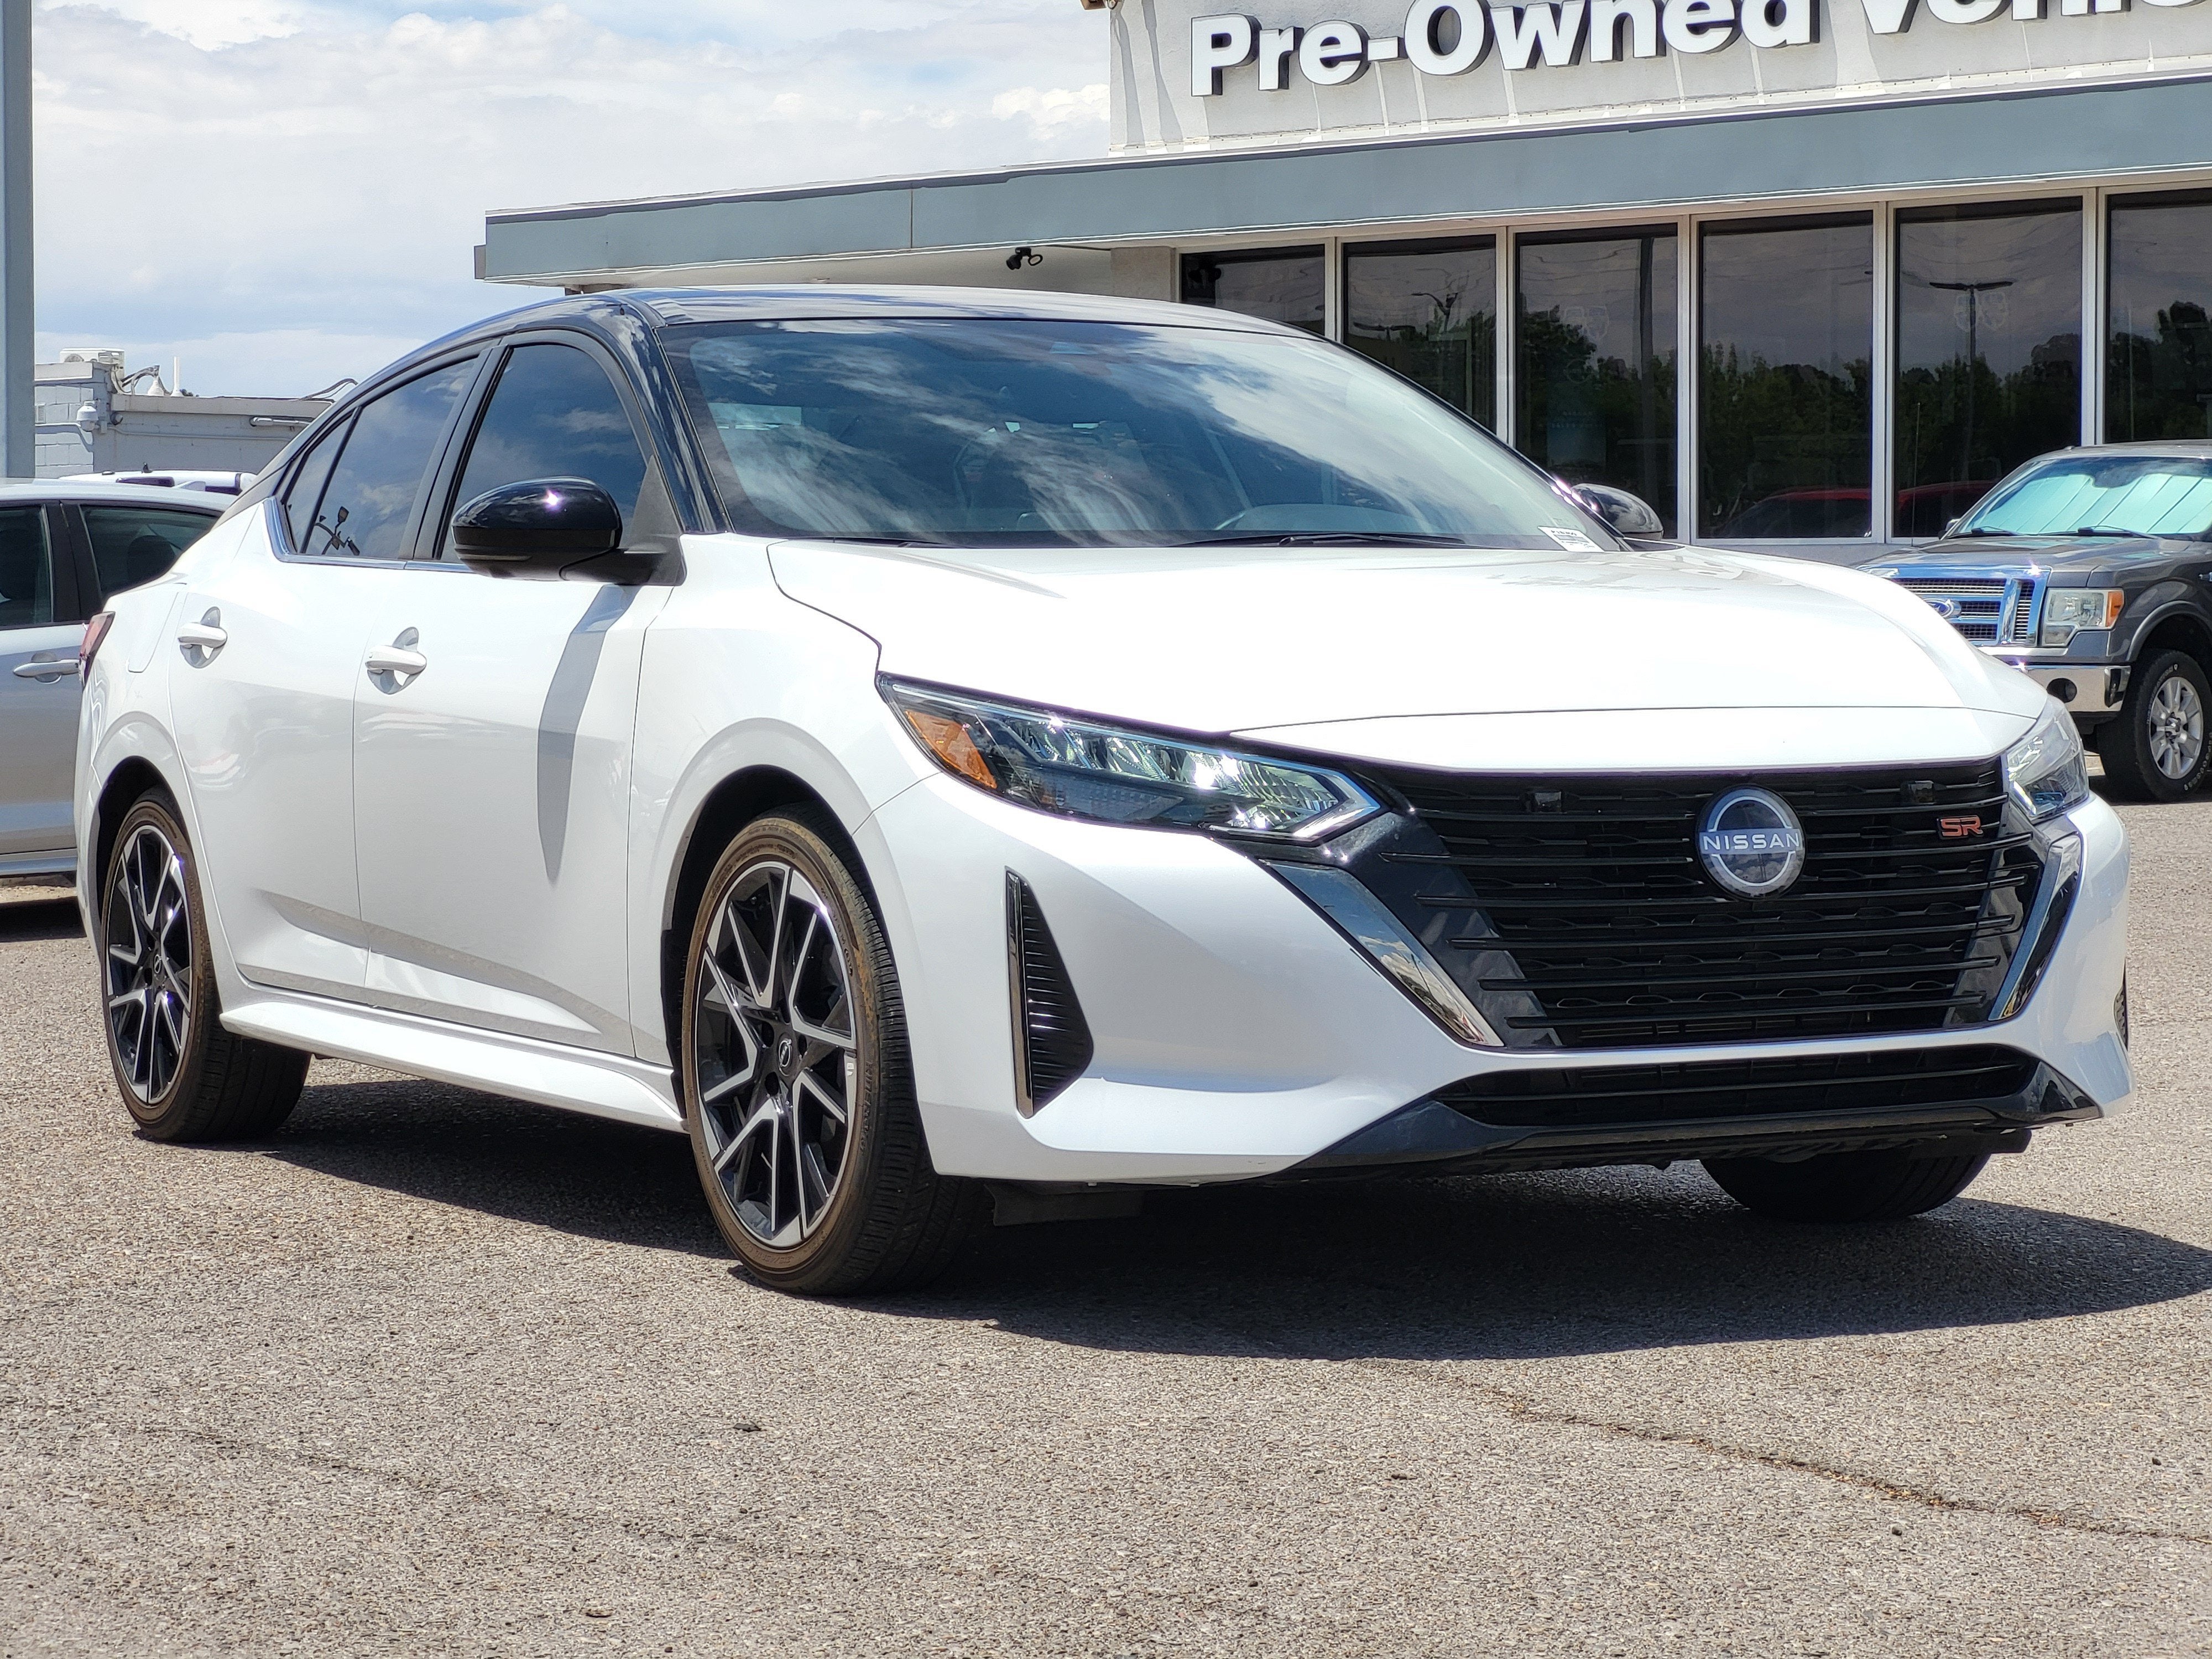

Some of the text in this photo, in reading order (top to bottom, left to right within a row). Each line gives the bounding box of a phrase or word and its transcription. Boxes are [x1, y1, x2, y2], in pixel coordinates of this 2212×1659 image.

[1191, 0, 1817, 97] Pre-Owned
[1940, 816, 1983, 837] SR
[1703, 832, 1800, 851] NISSAN
